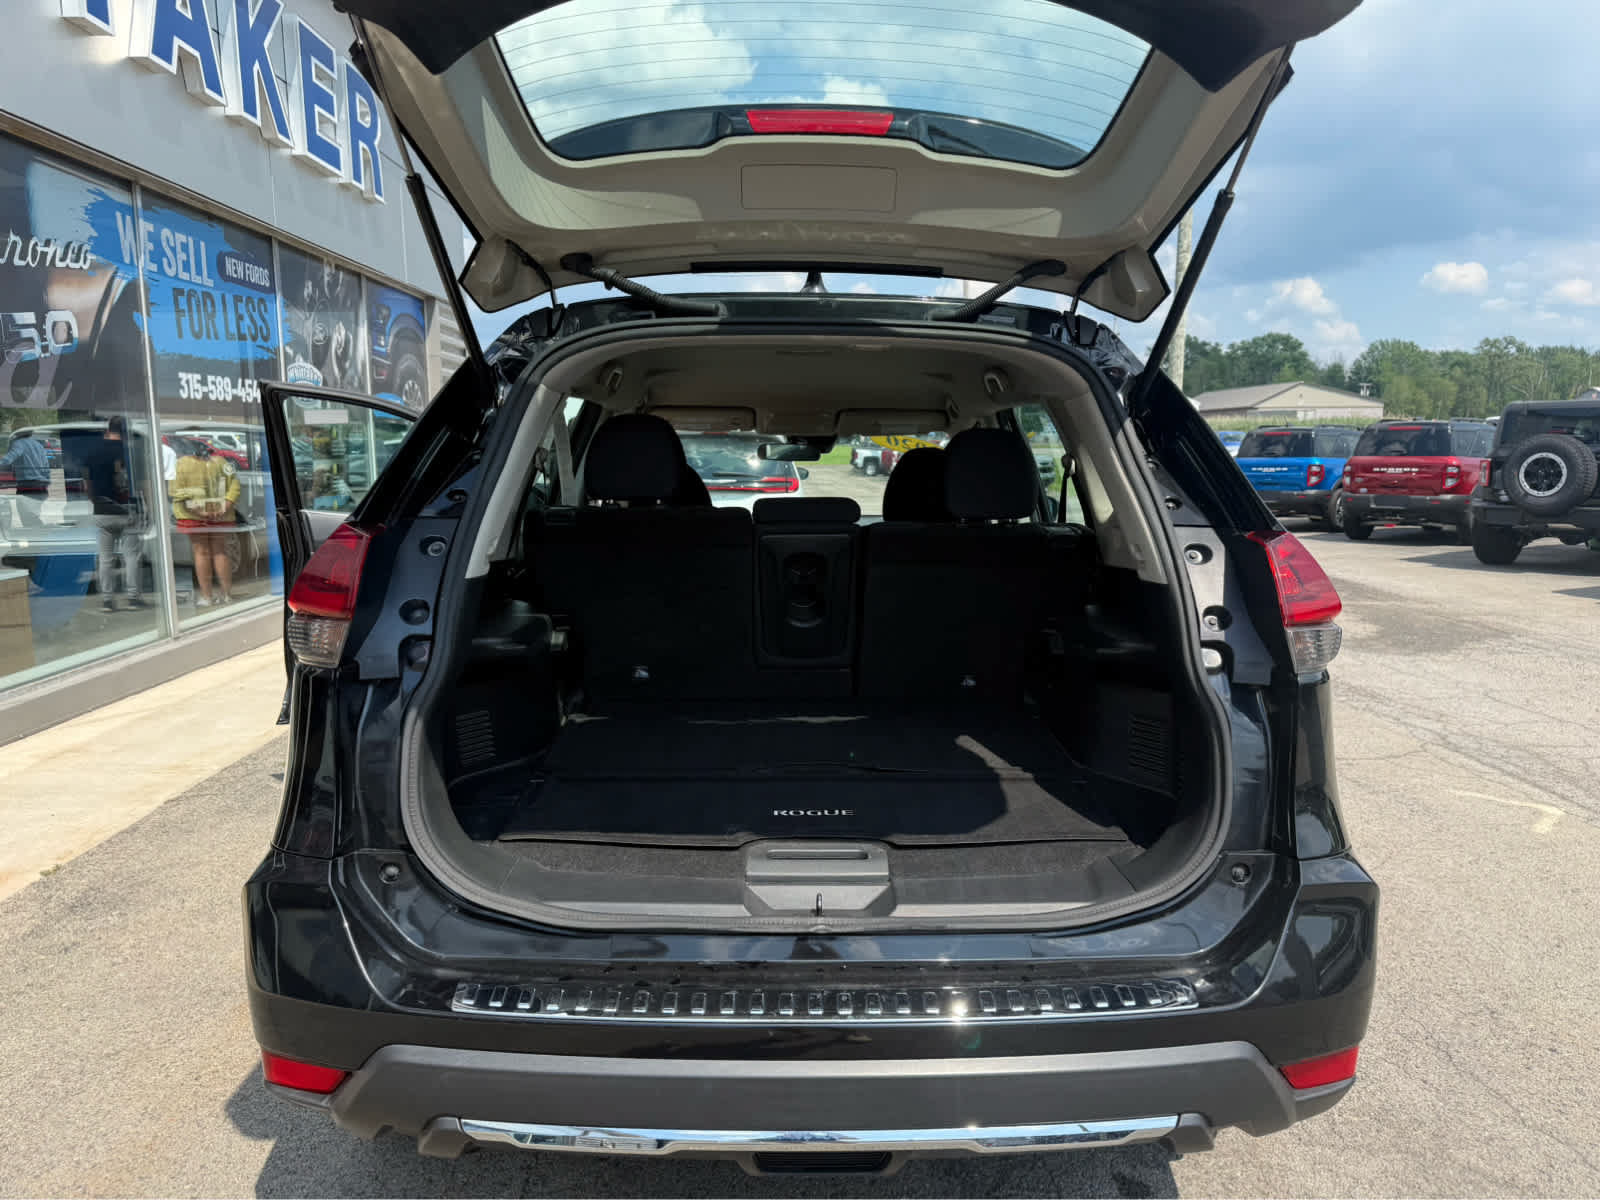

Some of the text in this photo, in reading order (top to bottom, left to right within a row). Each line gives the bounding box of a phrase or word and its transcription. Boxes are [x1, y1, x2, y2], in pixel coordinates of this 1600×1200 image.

[60, 0, 386, 204] AKER
[0, 228, 96, 270] ronco
[115, 210, 215, 287] WE SELL
[225, 255, 271, 288] NEW FORDS
[172, 287, 271, 343] FOR LESS
[177, 371, 262, 404] 315-589-454
